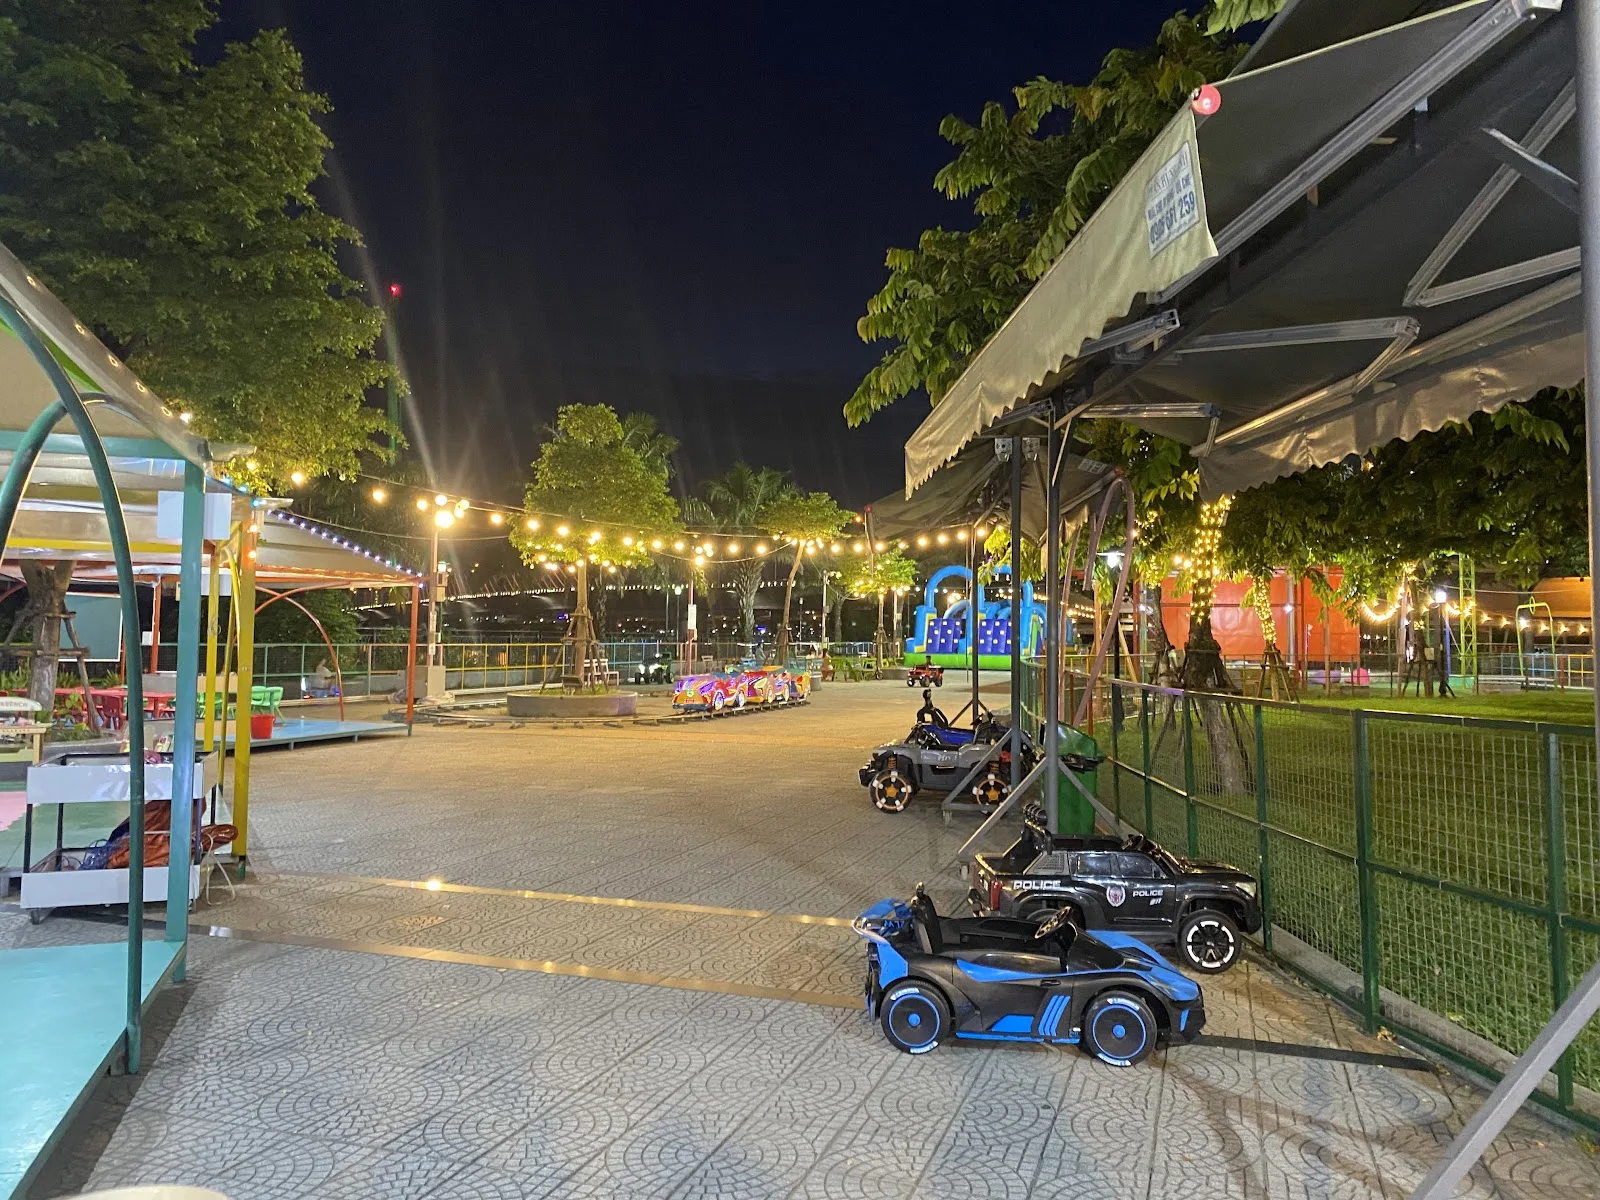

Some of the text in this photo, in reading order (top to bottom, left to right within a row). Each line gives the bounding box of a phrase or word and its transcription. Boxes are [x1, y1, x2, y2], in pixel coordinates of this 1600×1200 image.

[1179, 191, 1195, 218] 259
[1013, 880, 1061, 890] POLICE
[1132, 889, 1163, 897] POLICE
